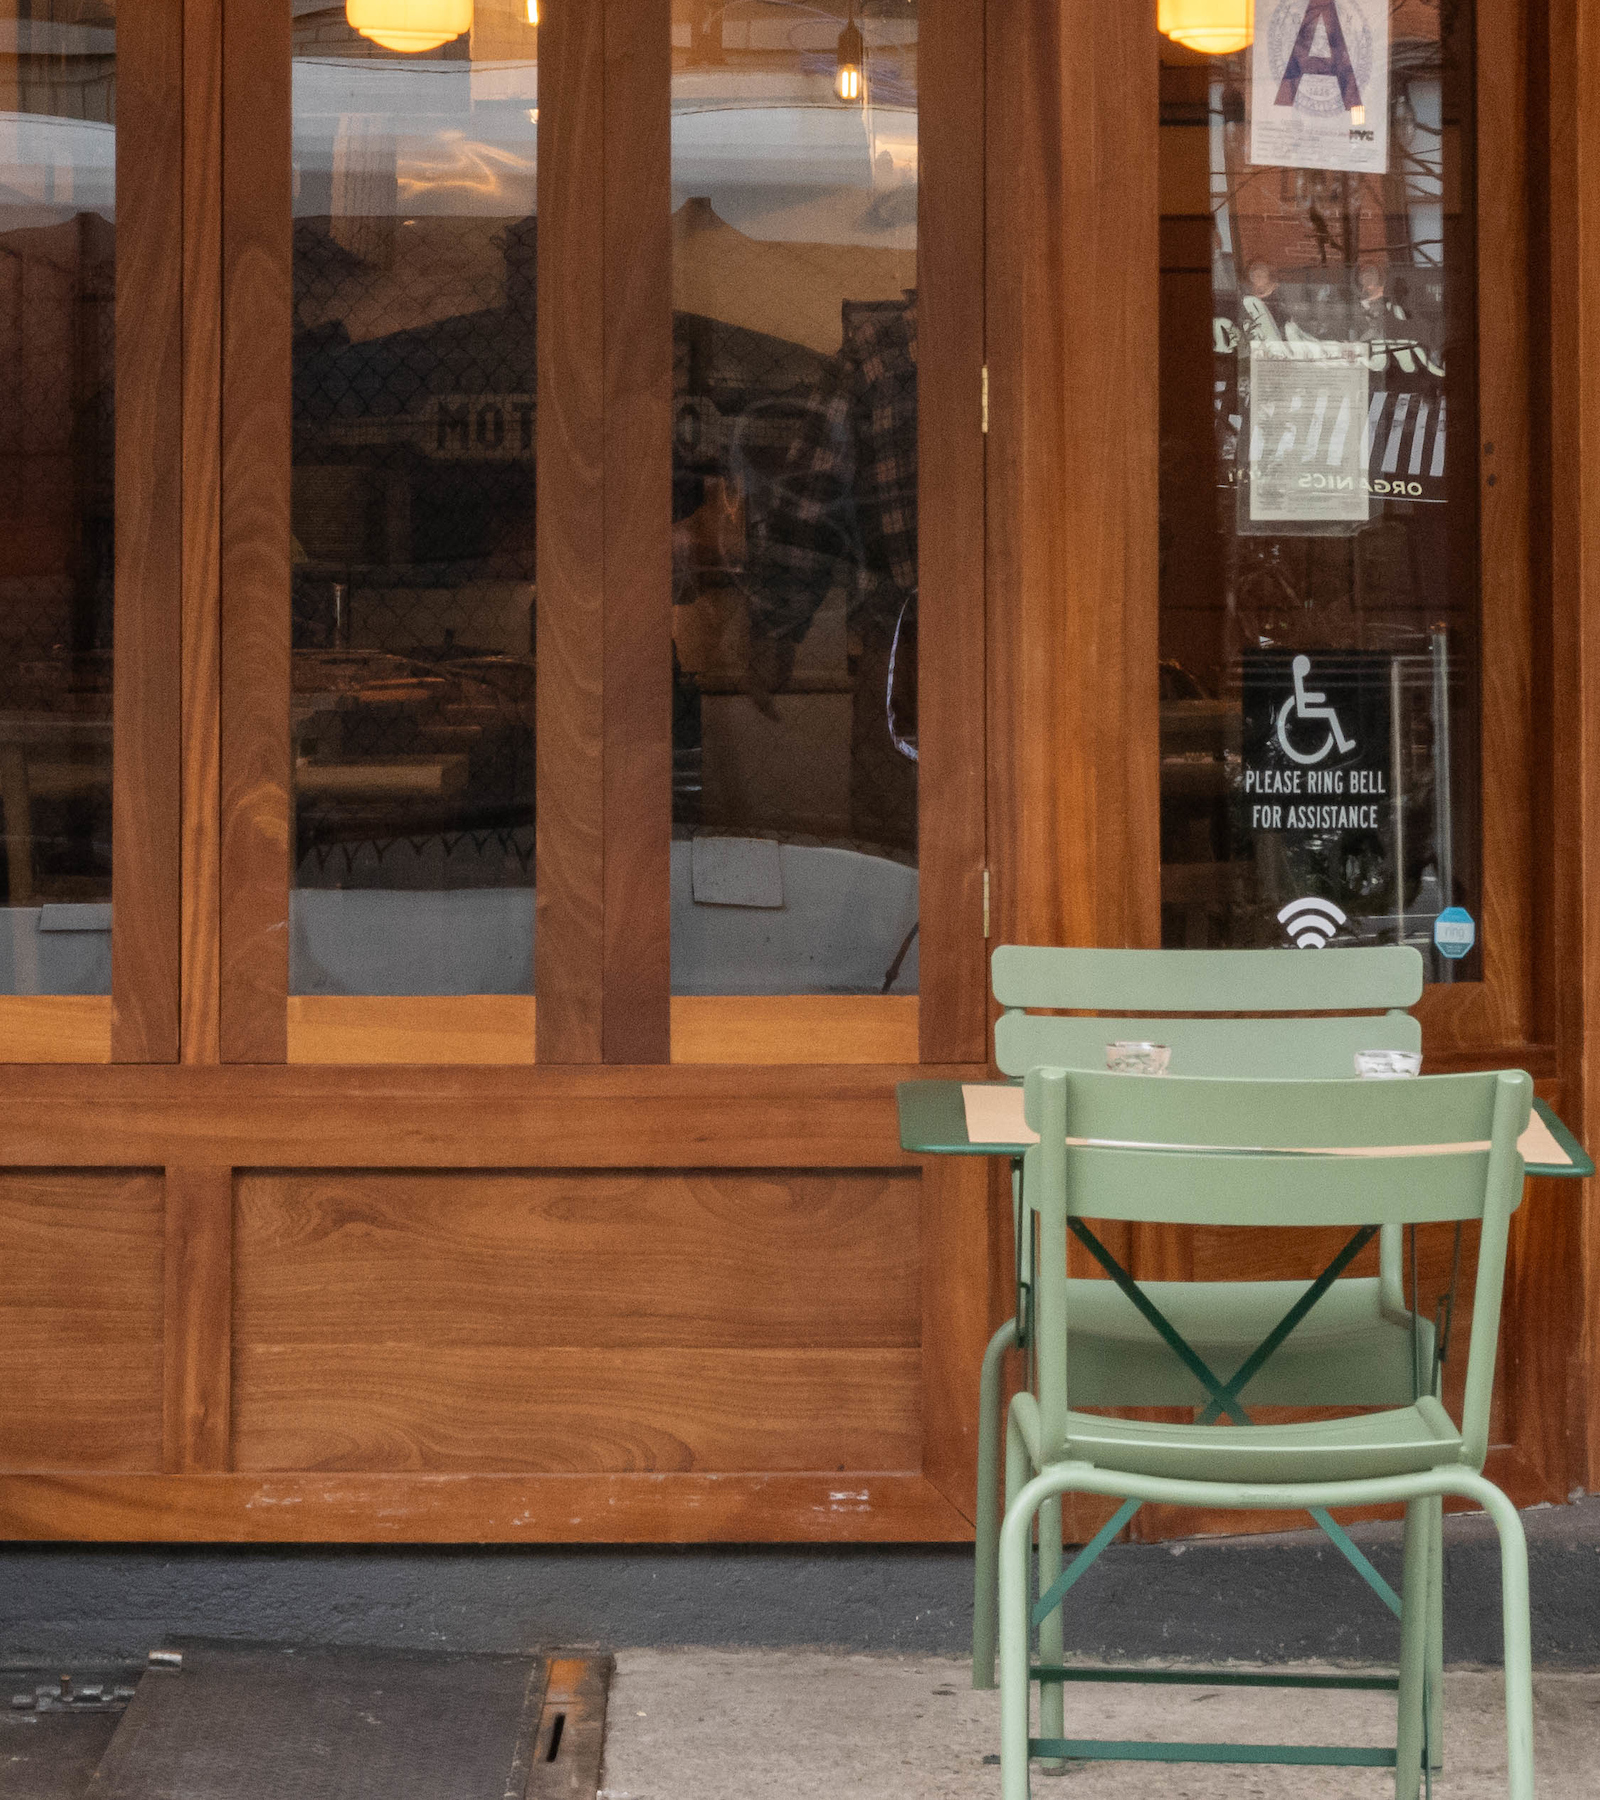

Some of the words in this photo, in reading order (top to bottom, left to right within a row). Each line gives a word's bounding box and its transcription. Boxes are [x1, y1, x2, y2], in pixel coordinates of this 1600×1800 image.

[1245, 770, 1301, 794] PLEASE
[1307, 770, 1344, 794] RING
[1350, 770, 1386, 794] BELL
[1252, 805, 1282, 828] FOR
[1287, 805, 1378, 828] ASSISTANCE
